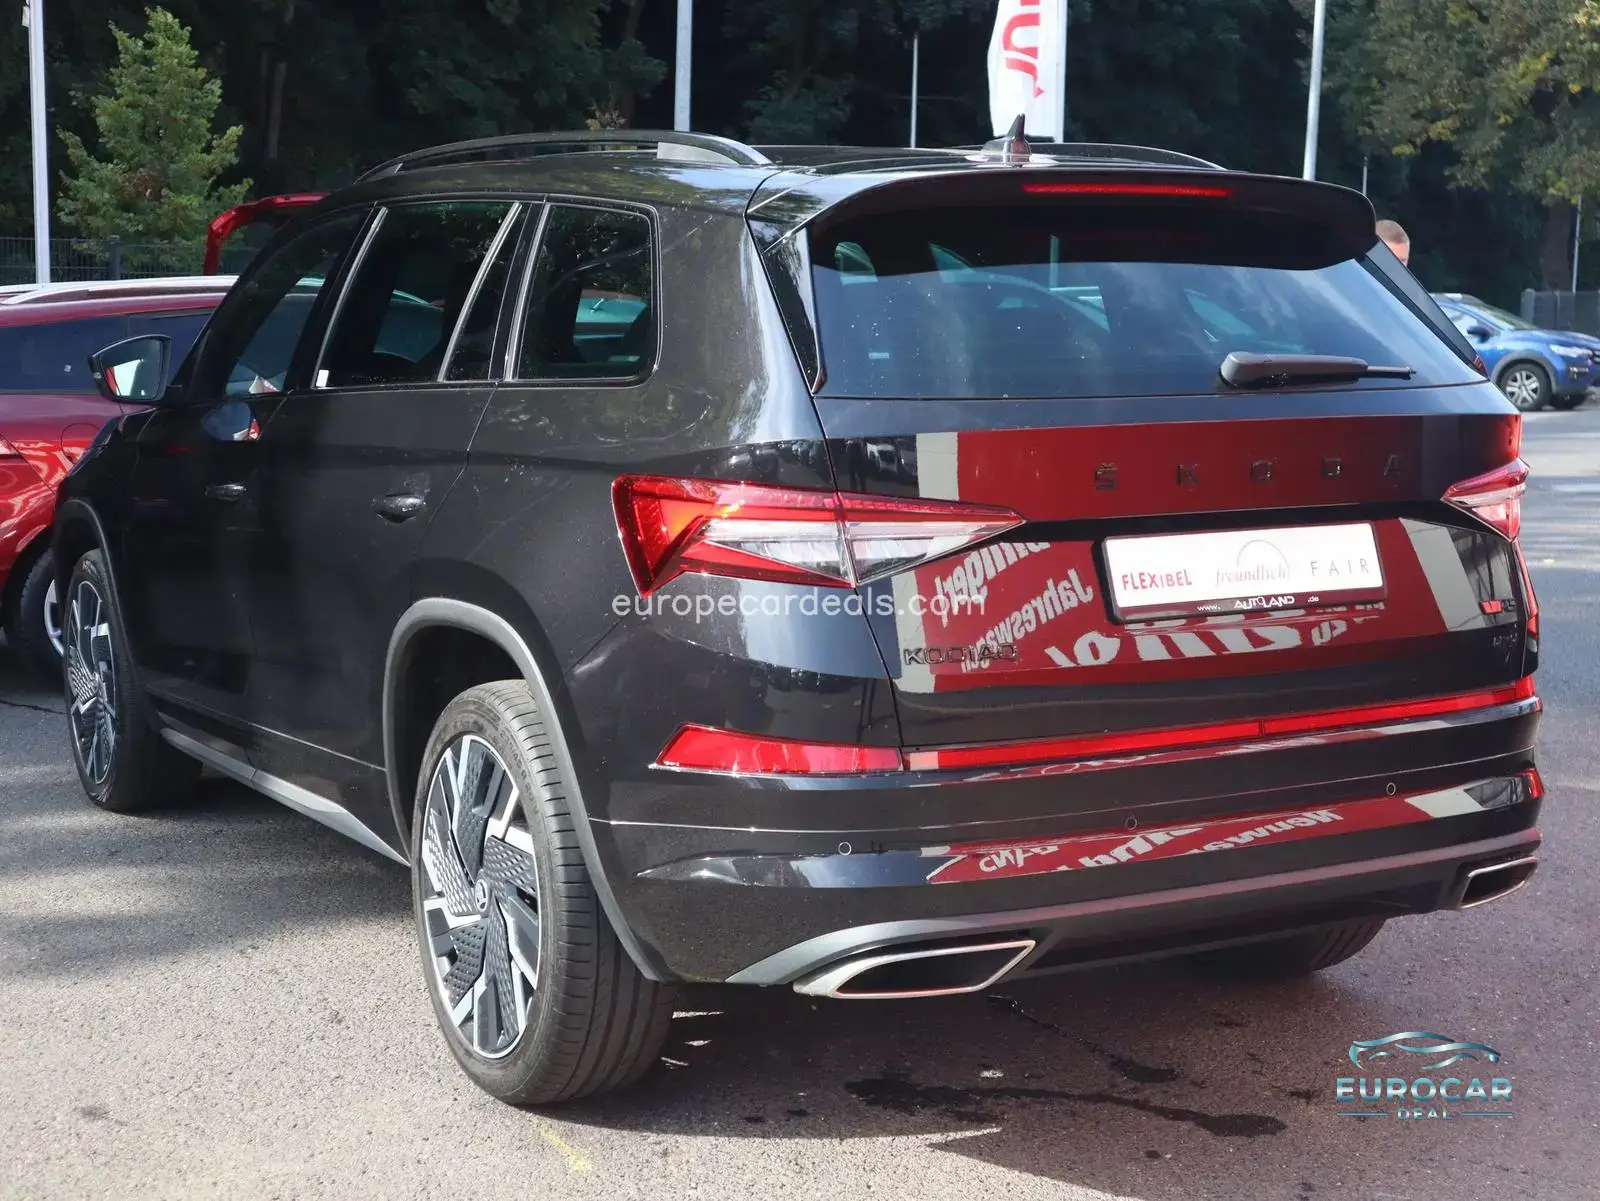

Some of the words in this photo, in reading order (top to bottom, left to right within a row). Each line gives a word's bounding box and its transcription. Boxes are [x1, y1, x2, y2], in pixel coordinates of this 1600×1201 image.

[1122, 569, 1192, 591] FLEXIBEL
[1214, 564, 1288, 588] freundlich
[1310, 558, 1370, 578] FAIR
[1234, 595, 1295, 610] AUTOLAND
